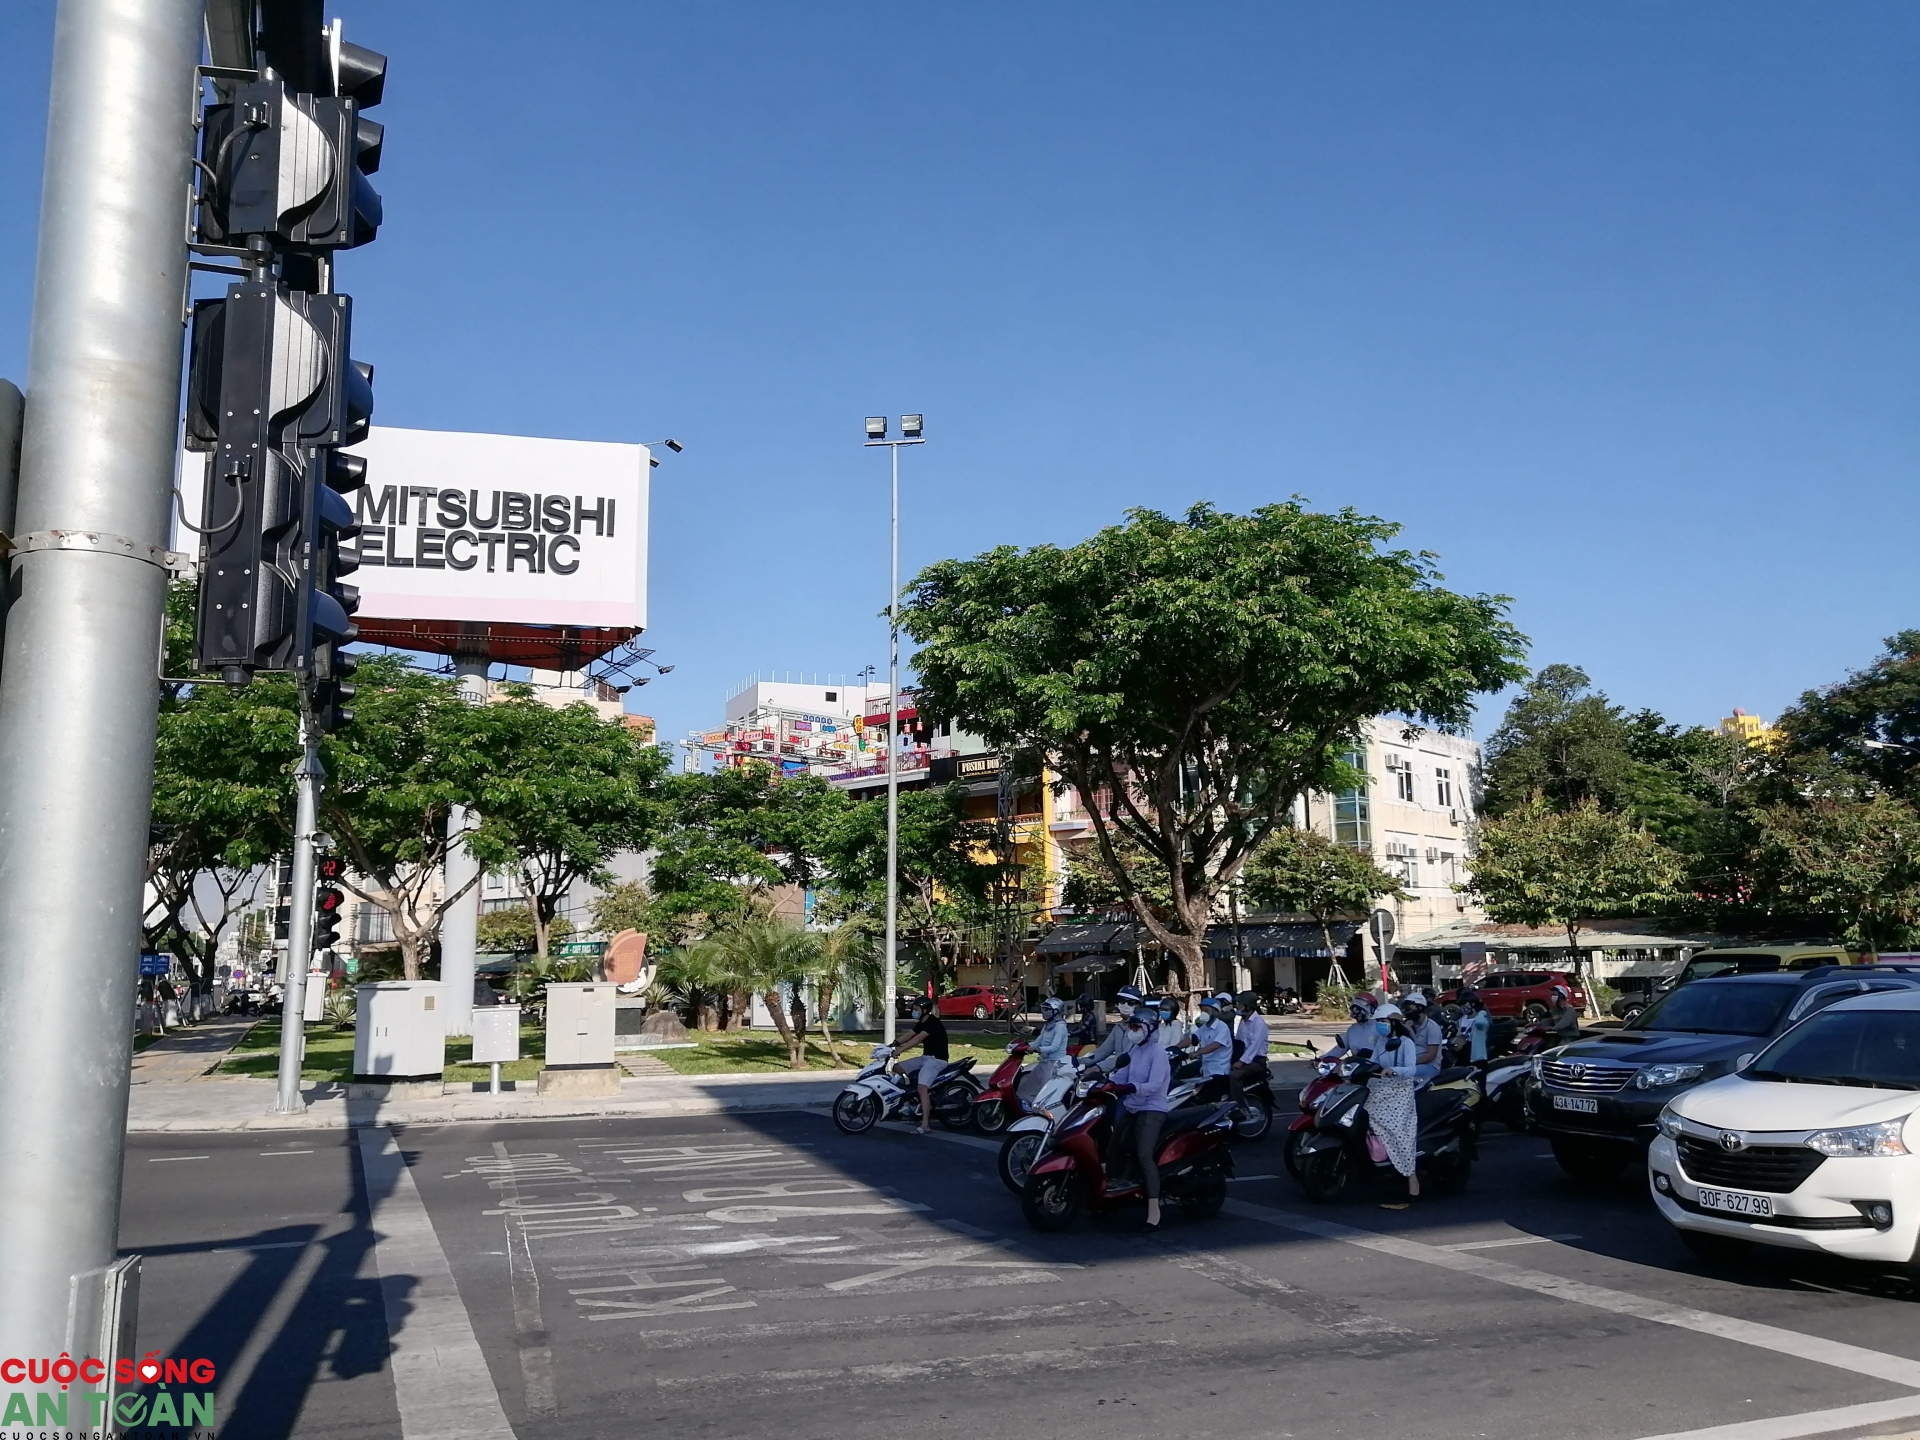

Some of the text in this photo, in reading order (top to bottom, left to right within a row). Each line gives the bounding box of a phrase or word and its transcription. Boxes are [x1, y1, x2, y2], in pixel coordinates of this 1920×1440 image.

[356, 484, 616, 537] MITSUBISHI
[355, 525, 581, 576] ELECTRIC
[1700, 1190, 1769, 1215] 30F-627.99
